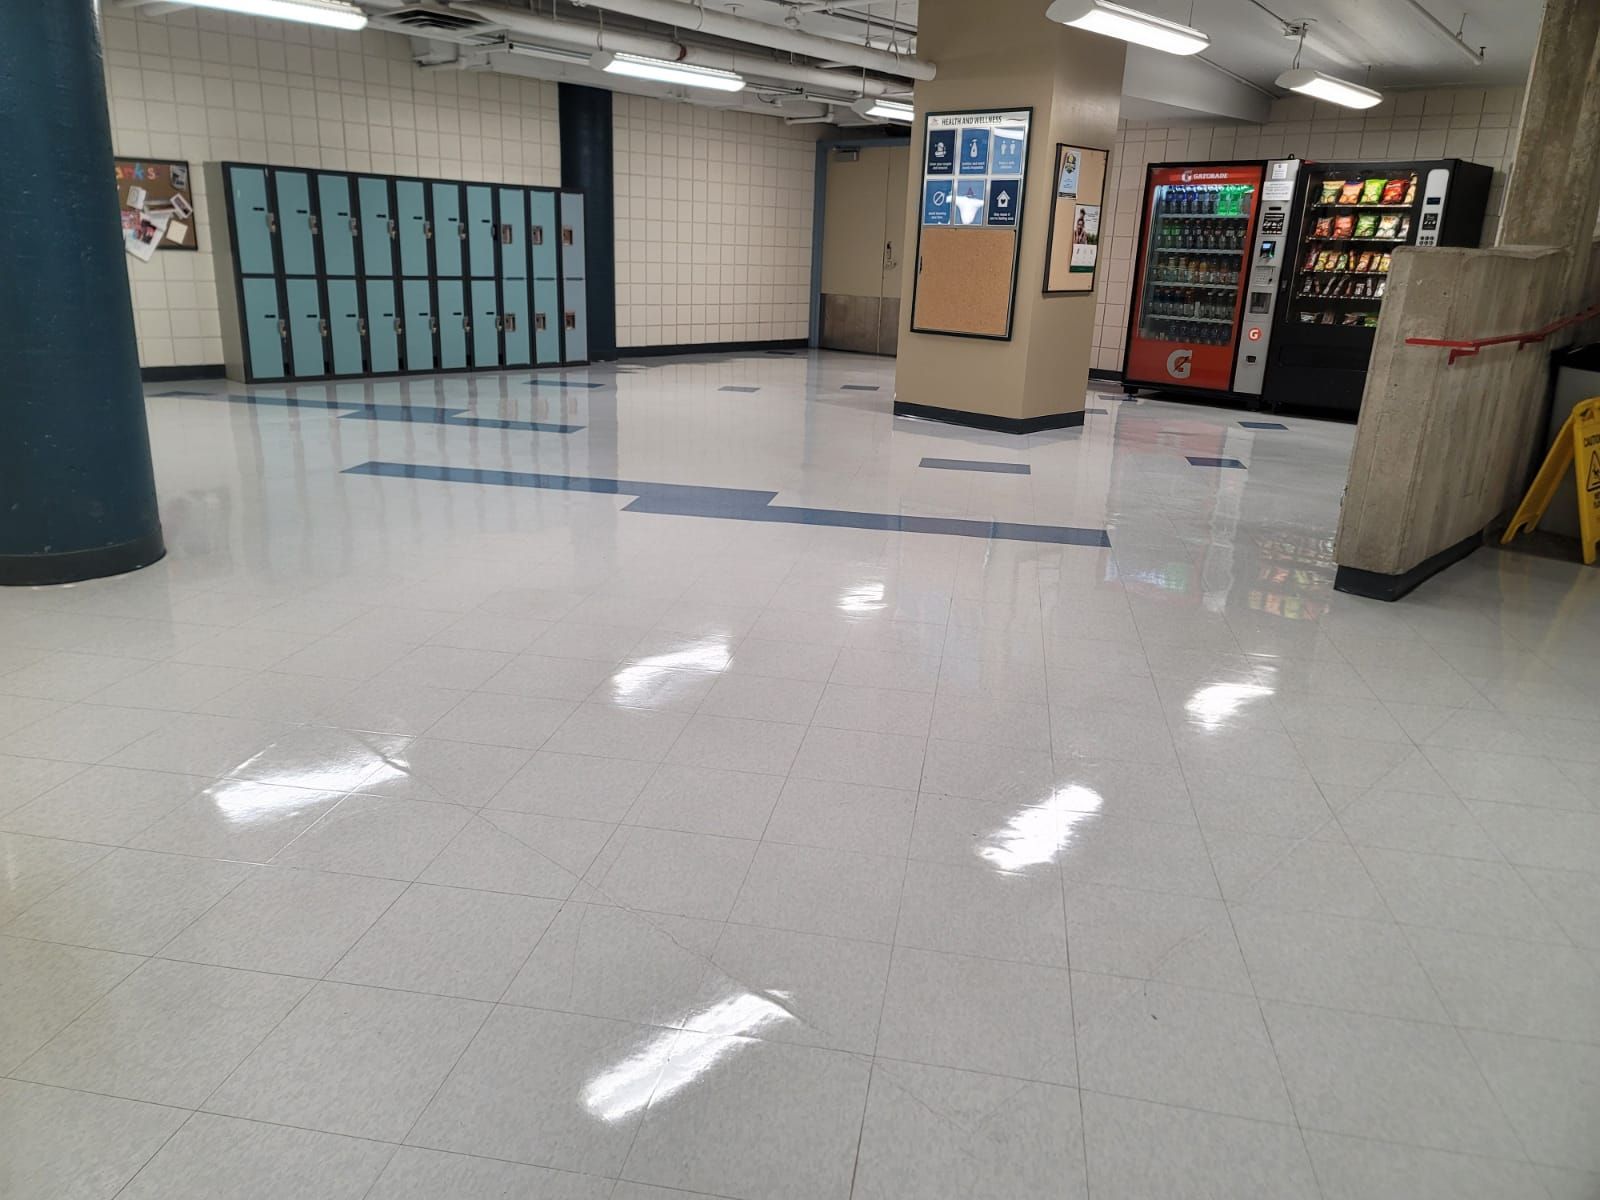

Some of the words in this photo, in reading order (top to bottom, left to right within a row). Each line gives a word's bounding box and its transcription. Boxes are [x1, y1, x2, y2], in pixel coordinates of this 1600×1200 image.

[942, 117, 961, 126] HEALTH
[962, 116, 973, 125] AND
[974, 116, 1002, 125] WELLNESS
[1167, 350, 1192, 379] G
